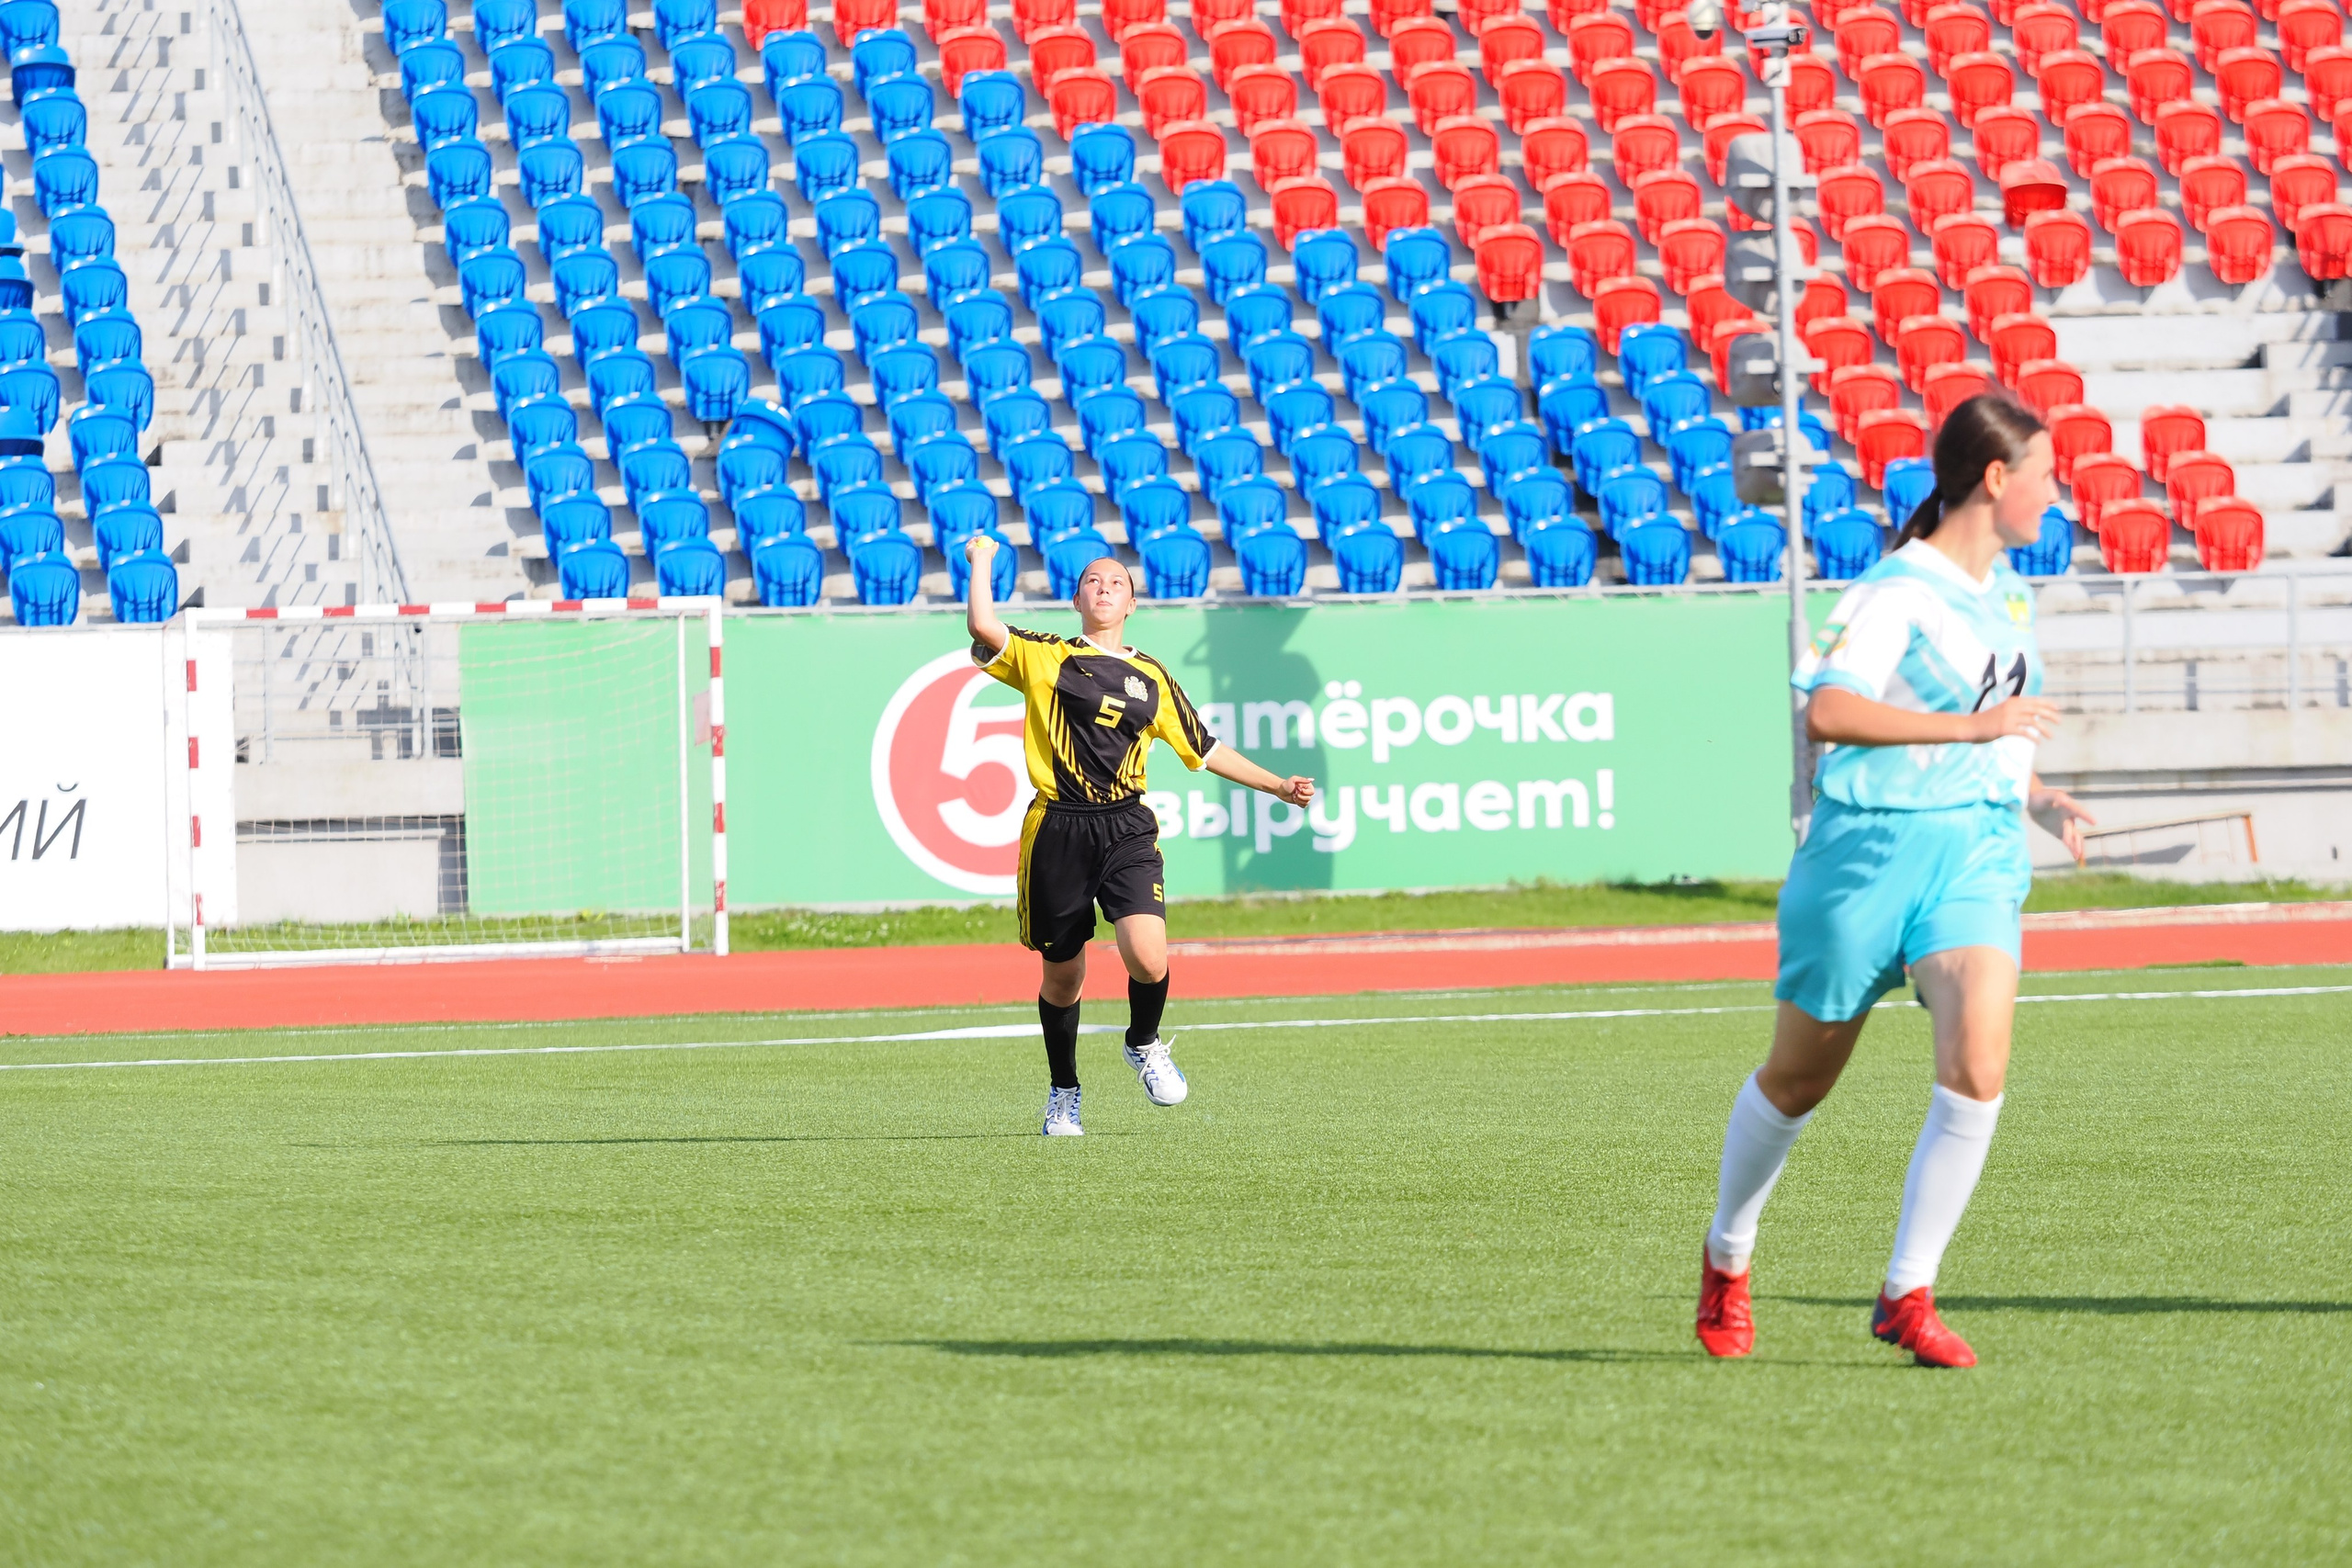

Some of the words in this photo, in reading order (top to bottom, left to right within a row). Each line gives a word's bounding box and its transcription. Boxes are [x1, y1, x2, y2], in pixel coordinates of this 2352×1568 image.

[1094, 694, 1126, 729] 5
[1148, 680, 1615, 763] ятёрочка
[937, 671, 1025, 848] 5
[1153, 883, 1163, 903] 5
